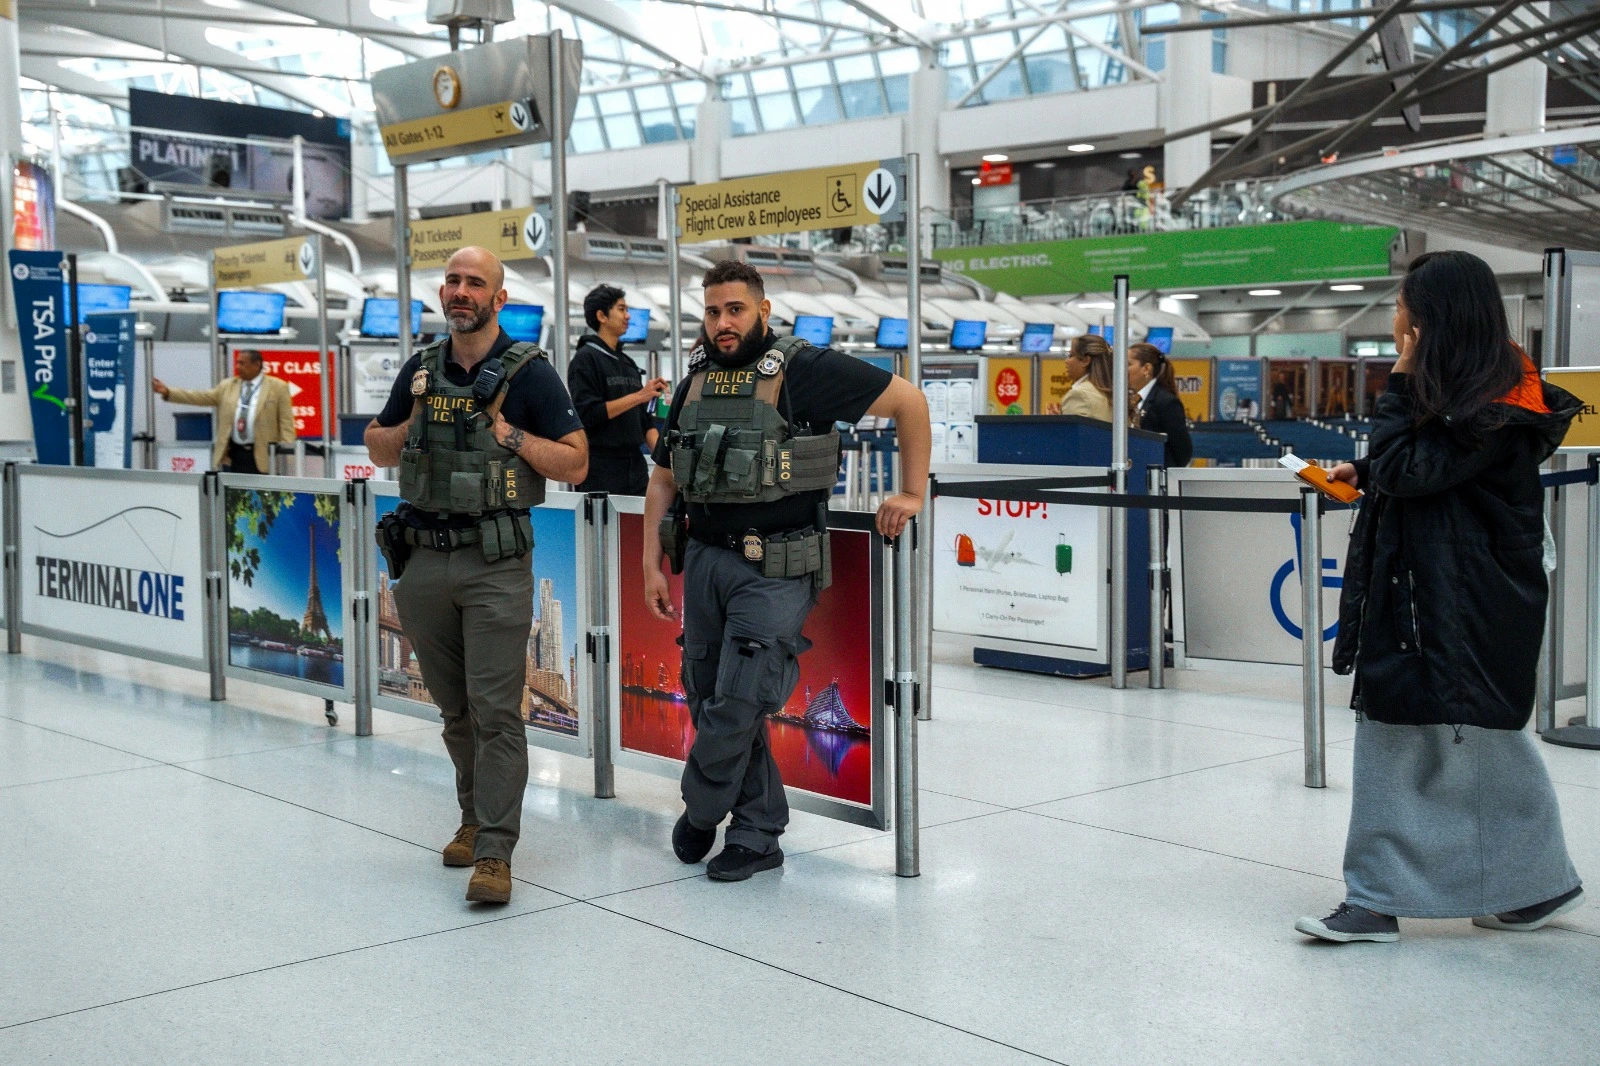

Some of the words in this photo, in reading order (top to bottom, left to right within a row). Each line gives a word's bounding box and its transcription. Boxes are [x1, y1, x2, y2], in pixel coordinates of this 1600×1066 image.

[386, 131, 398, 148] All
[400, 128, 424, 146] Gates
[424, 124, 445, 141] 1-12
[685, 194, 721, 214] Special
[723, 189, 780, 208] Assistance
[685, 214, 715, 235] Flight
[717, 213, 745, 230] Crew
[748, 211, 757, 226] &
[760, 206, 821, 228] Employees
[414, 229, 425, 245] All
[427, 226, 462, 242] Ticketed
[32, 295, 56, 340] TSA
[34, 345, 57, 384] Pre
[88, 357, 115, 368] Enter
[283, 361, 323, 374] CLAS
[90, 368, 115, 378] Here
[706, 370, 755, 384] POLICE
[714, 384, 740, 395] ICE
[997, 383, 1019, 397] $32
[427, 396, 475, 413] POLICE
[963, 585, 983, 593] Personal
